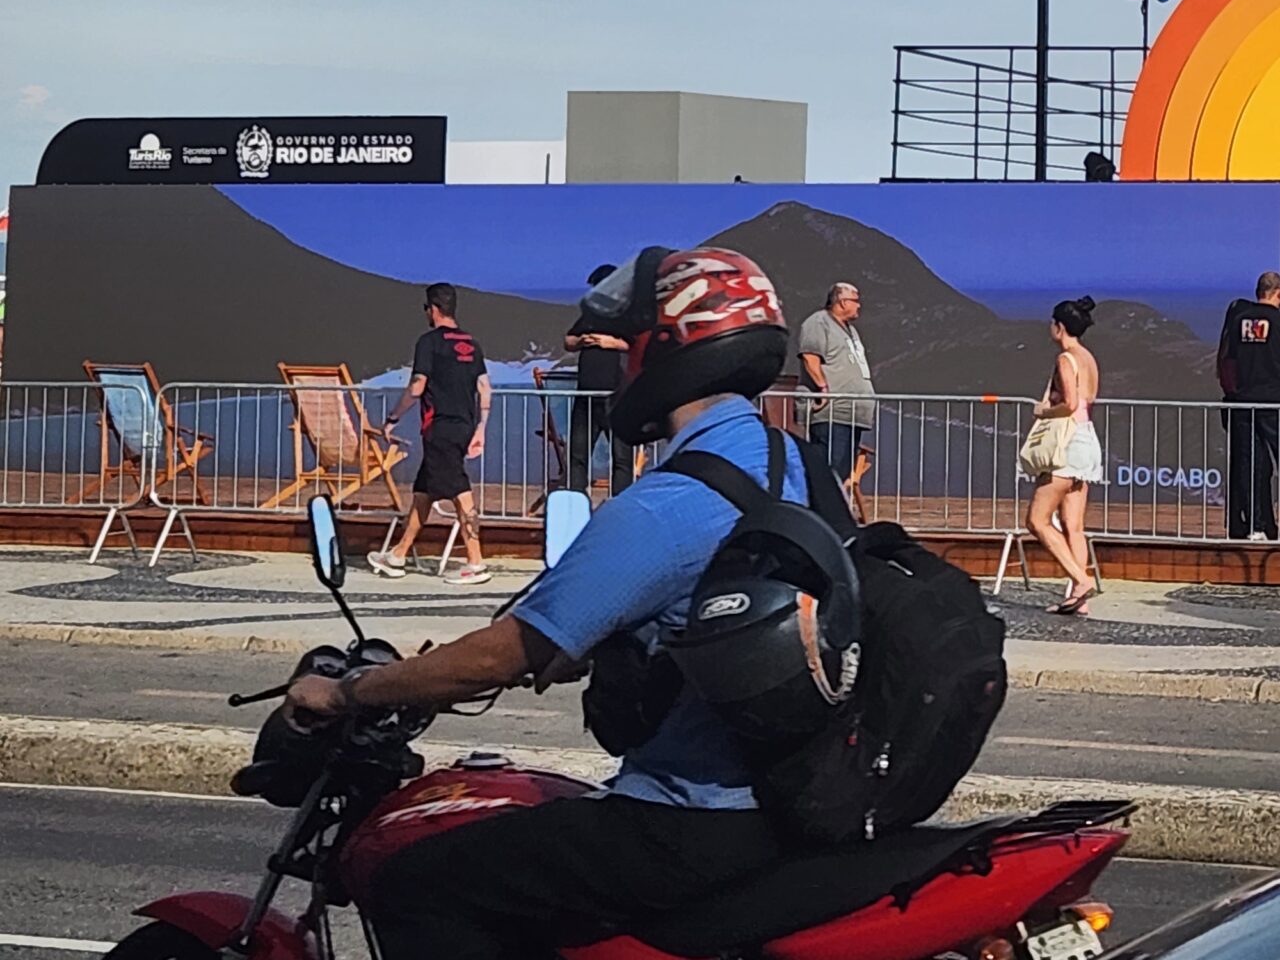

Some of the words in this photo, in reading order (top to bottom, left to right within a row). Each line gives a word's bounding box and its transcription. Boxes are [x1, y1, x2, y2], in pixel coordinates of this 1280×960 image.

[276, 136, 335, 145] GOVERNO
[341, 136, 357, 145] DO
[363, 135, 413, 145] ESTADO
[276, 147, 308, 164] RIO
[311, 147, 334, 163] DE
[337, 146, 412, 163] JANEIRO
[1117, 465, 1151, 486] DO
[1157, 467, 1222, 488] CABO
